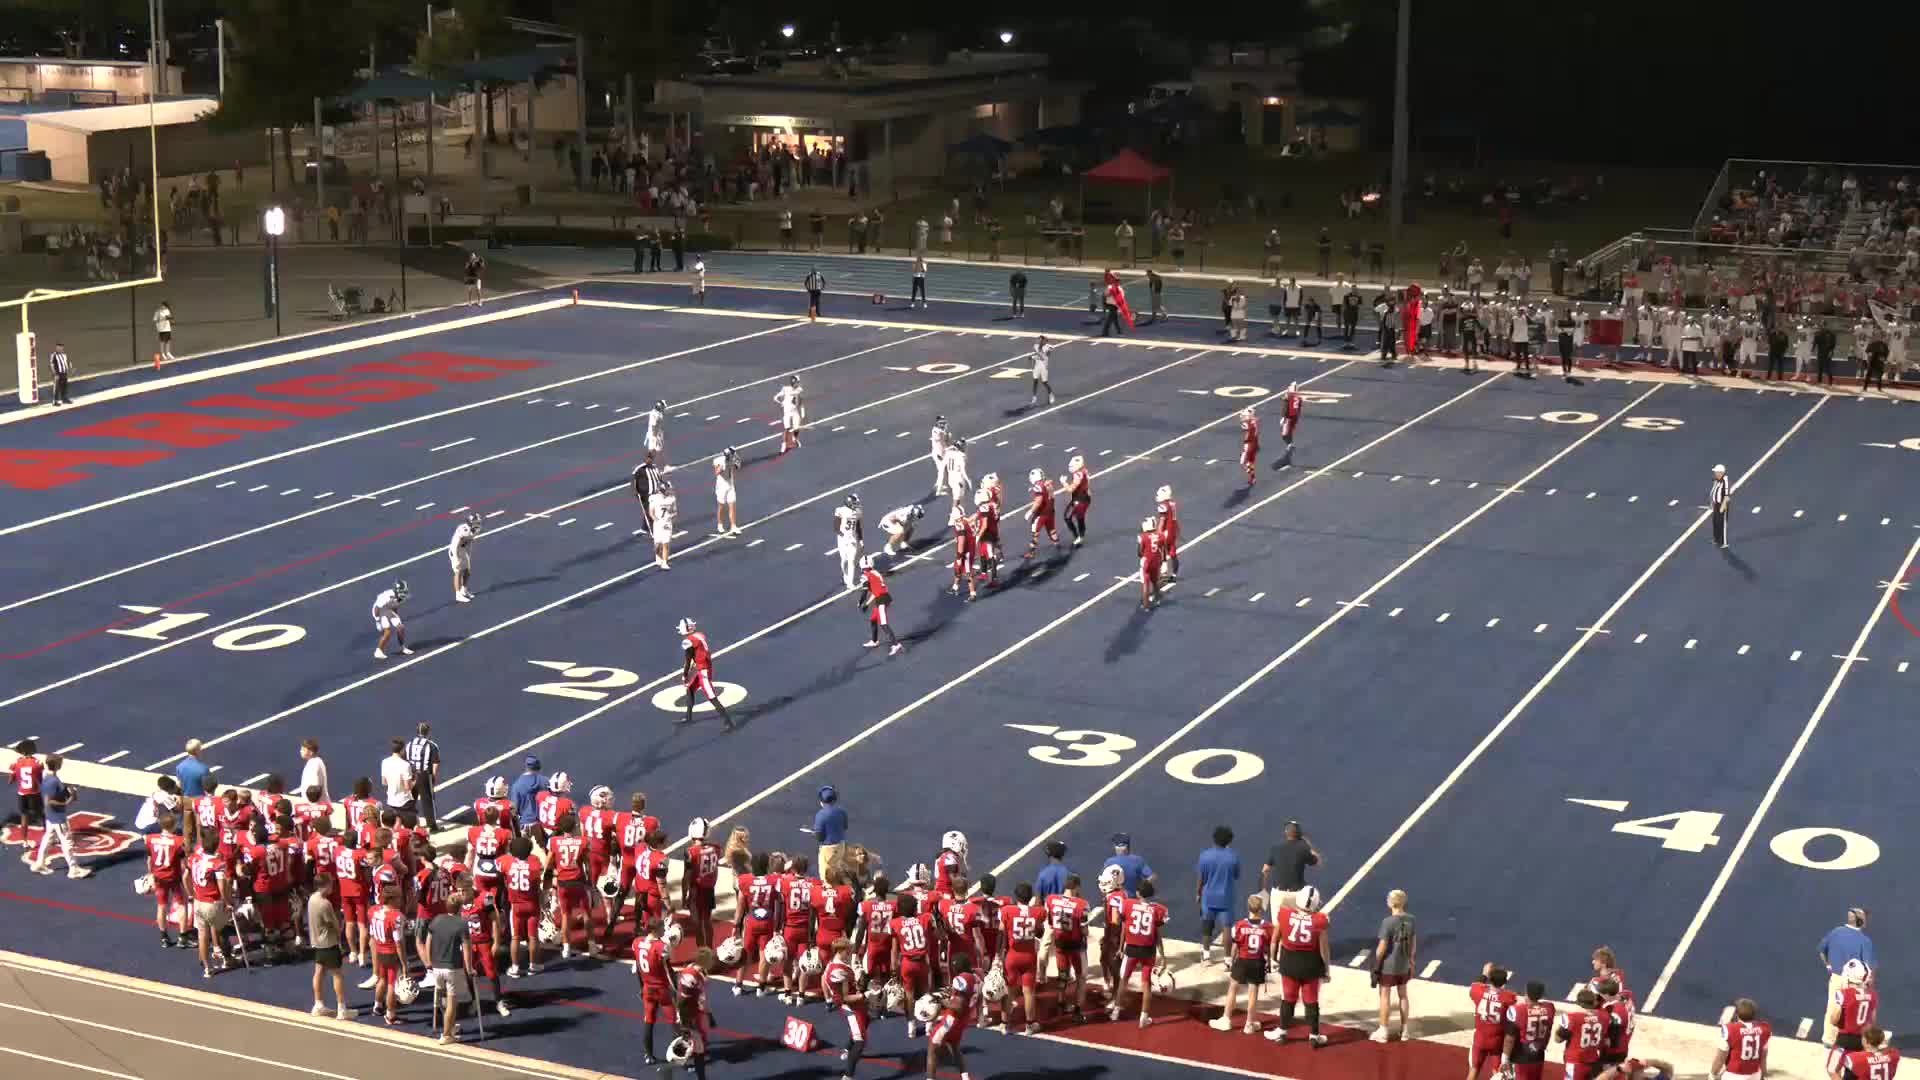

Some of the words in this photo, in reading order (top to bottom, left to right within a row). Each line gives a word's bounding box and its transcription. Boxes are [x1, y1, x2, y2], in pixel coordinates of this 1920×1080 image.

[522, 665, 749, 714] 20
[1027, 729, 1265, 786] 30
[19, 766, 33, 789] 5
[624, 824, 647, 848] 88
[1611, 810, 1882, 871] 40
[152, 844, 171, 867] 71
[335, 856, 357, 880] 99
[559, 845, 580, 868] 37
[508, 868, 530, 892] 36
[749, 884, 773, 908] 77
[1012, 916, 1037, 941] 52
[1128, 910, 1154, 936] 39
[1287, 917, 1313, 943] 75
[900, 923, 927, 952] 30
[1247, 934, 1261, 954] 9
[638, 949, 651, 974] 6
[1476, 998, 1502, 1024] 45
[1855, 1000, 1870, 1025] 0
[783, 1019, 809, 1050] 30
[1579, 1022, 1603, 1049] 63
[1740, 1035, 1761, 1061] 61
